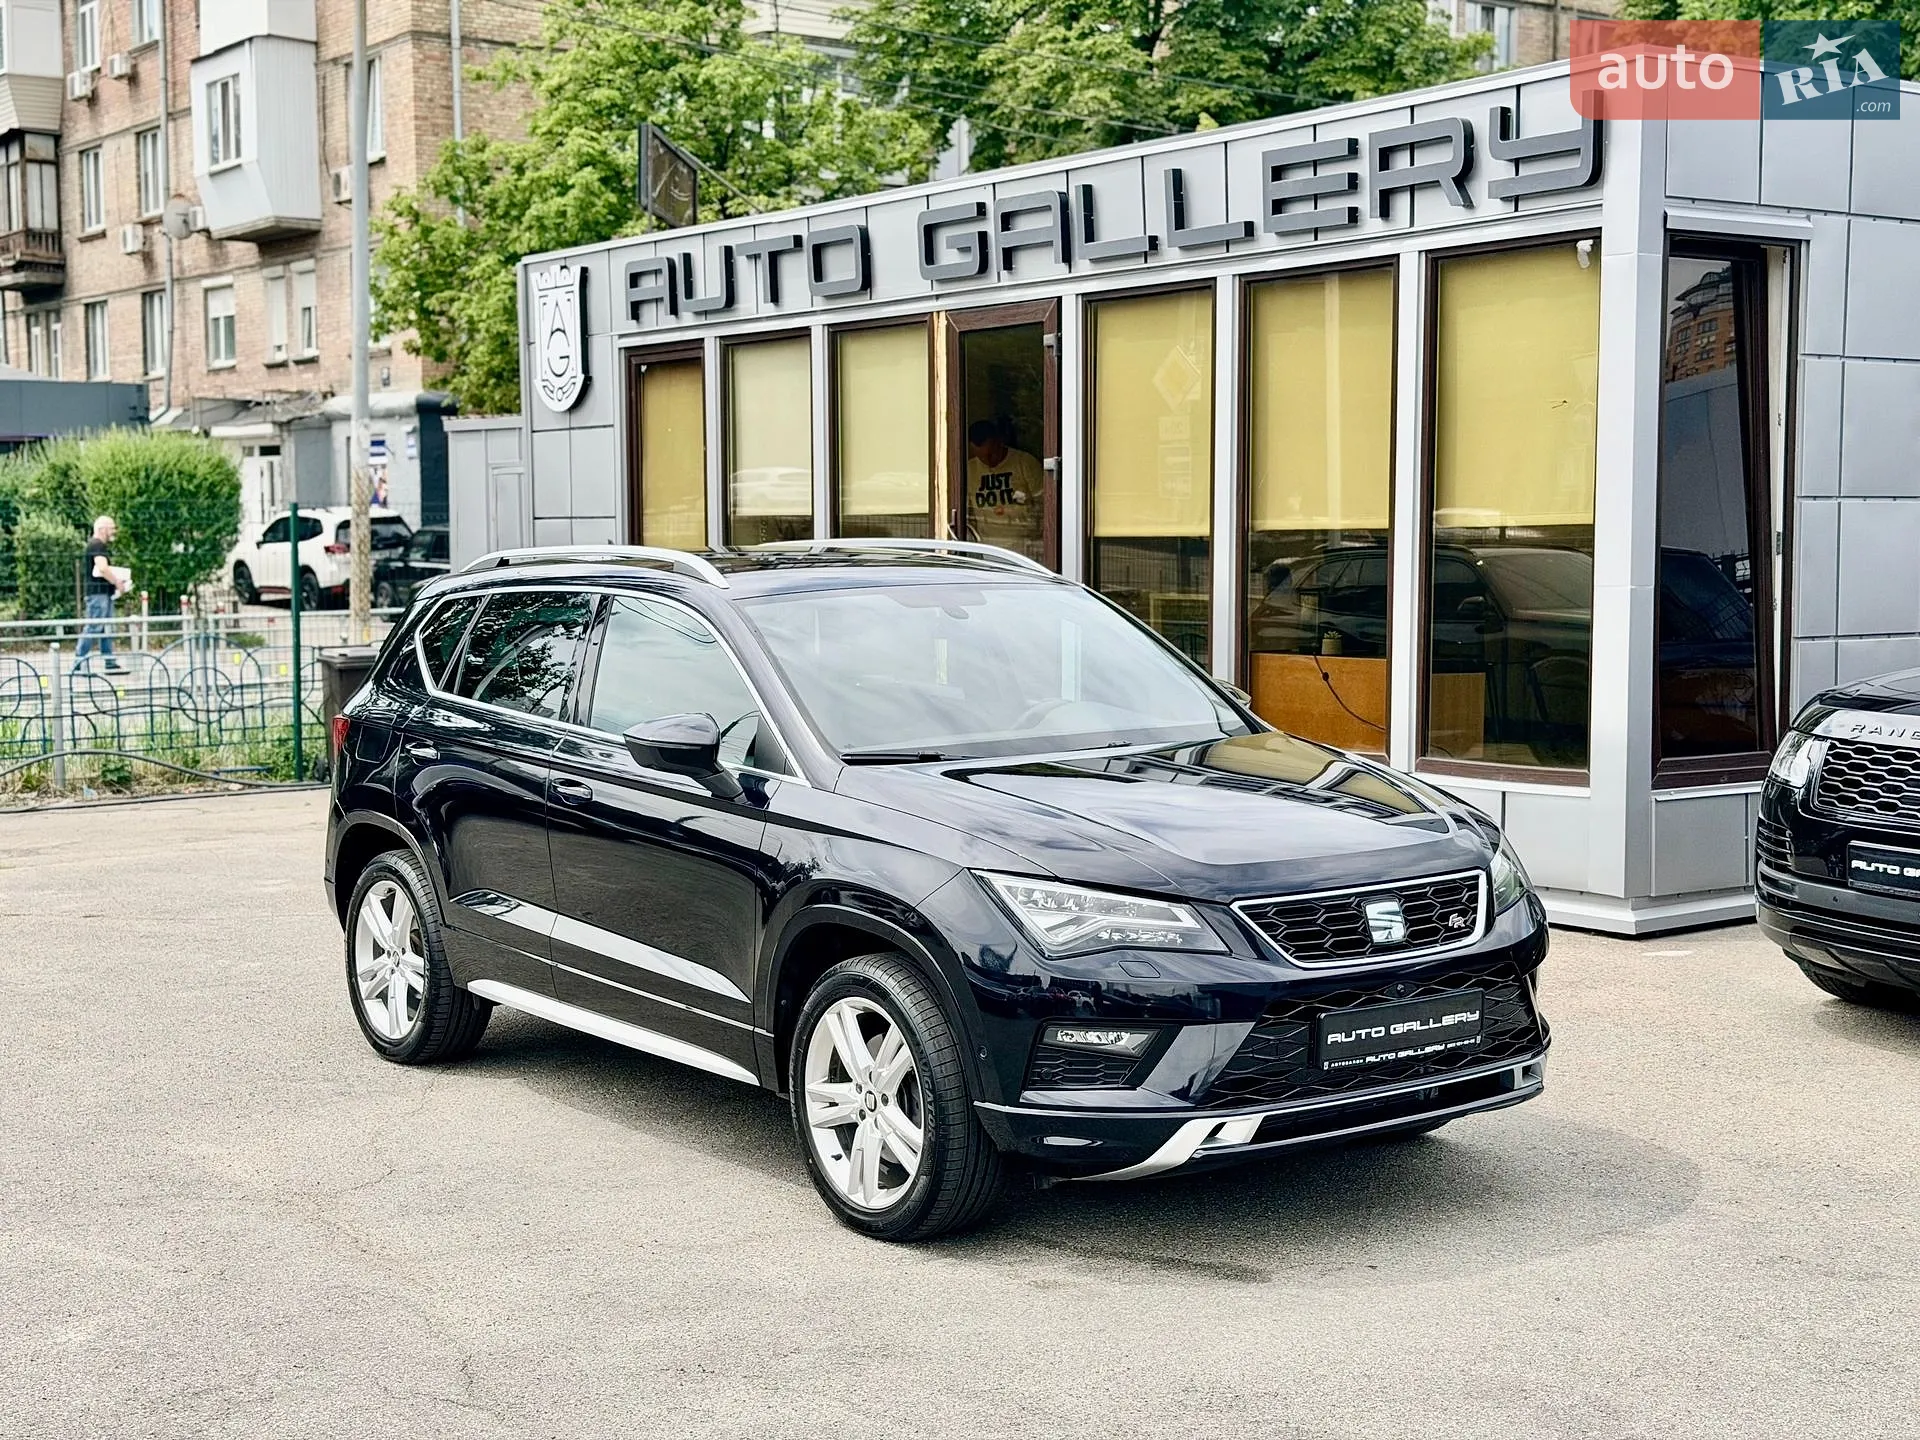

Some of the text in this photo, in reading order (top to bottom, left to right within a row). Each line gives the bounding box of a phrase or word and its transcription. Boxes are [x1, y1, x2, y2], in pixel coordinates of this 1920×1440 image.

[625, 89, 1605, 322] AUTO GALLERY
[979, 472, 1013, 491] JUST
[976, 491, 998, 508] DO
[1851, 860, 1900, 875] AUTO
[1327, 1010, 1480, 1045] AUTO GALLERY
[1365, 1052, 1396, 1064] AUTO
[1397, 1043, 1446, 1059] GALLERY
